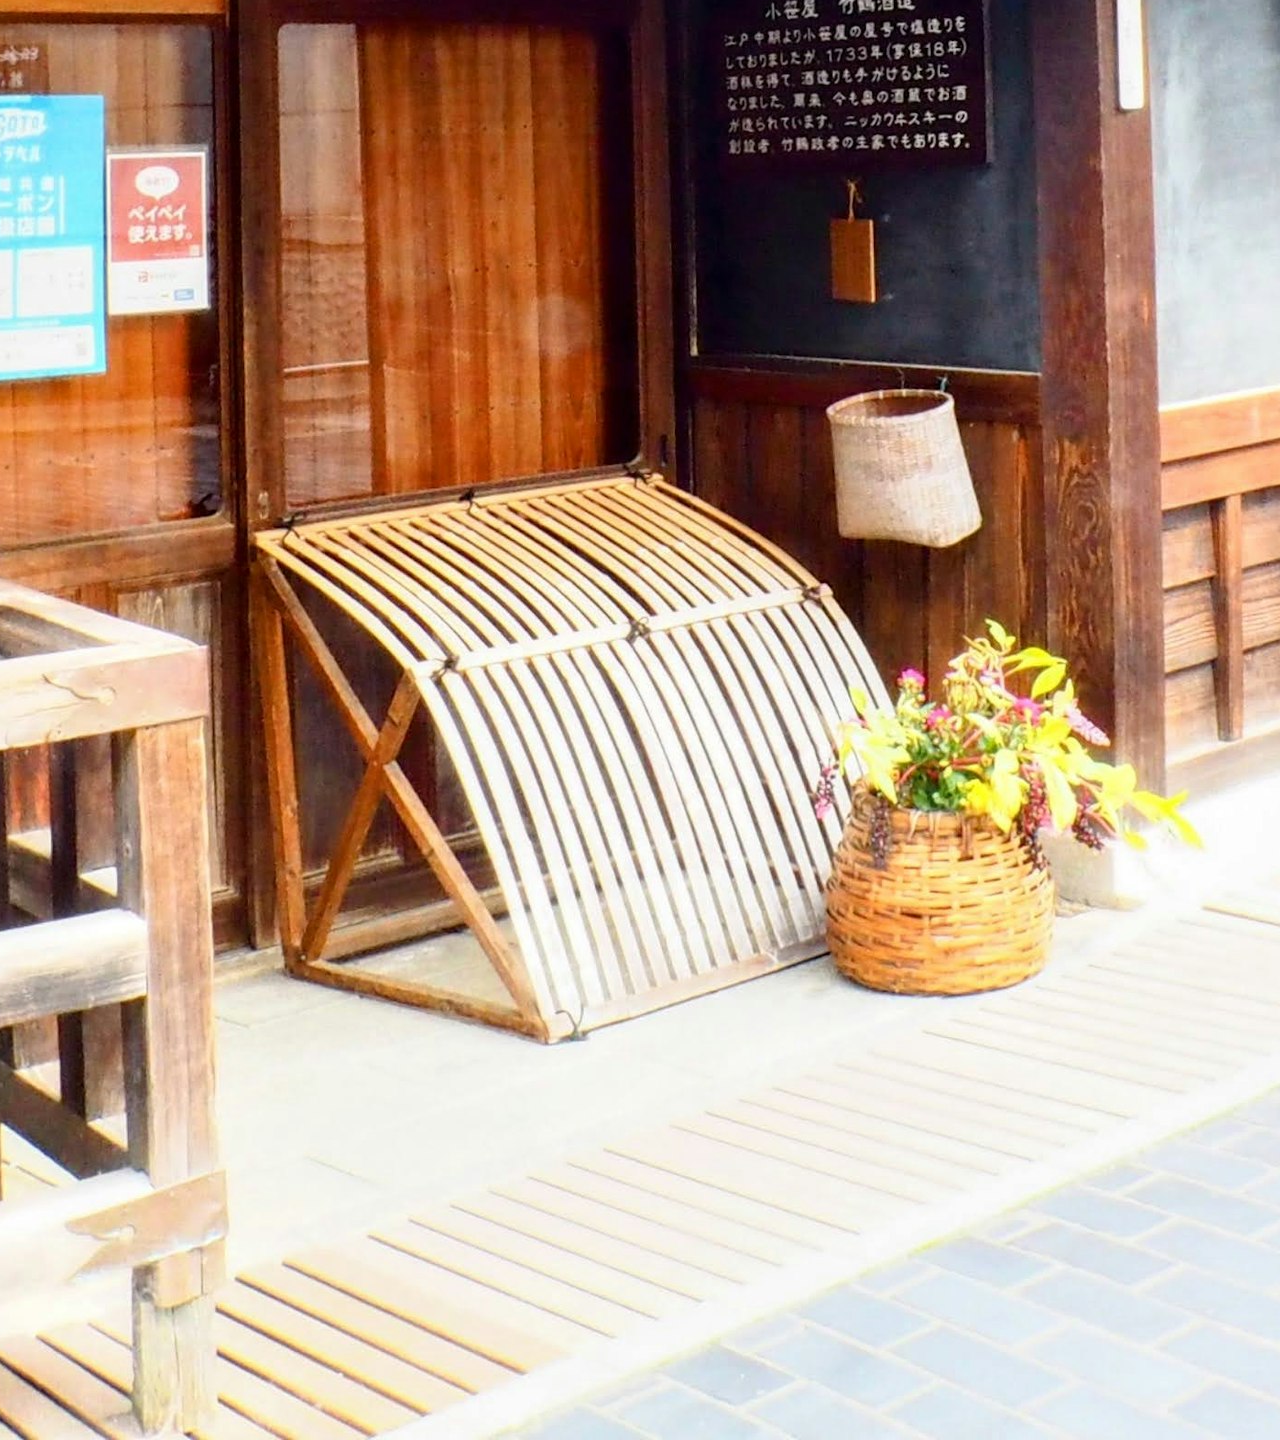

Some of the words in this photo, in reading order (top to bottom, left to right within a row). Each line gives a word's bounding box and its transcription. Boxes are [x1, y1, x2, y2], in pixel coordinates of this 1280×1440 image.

[127, 204, 186, 222] ペイペイ
[127, 223, 194, 245] 使えます。
